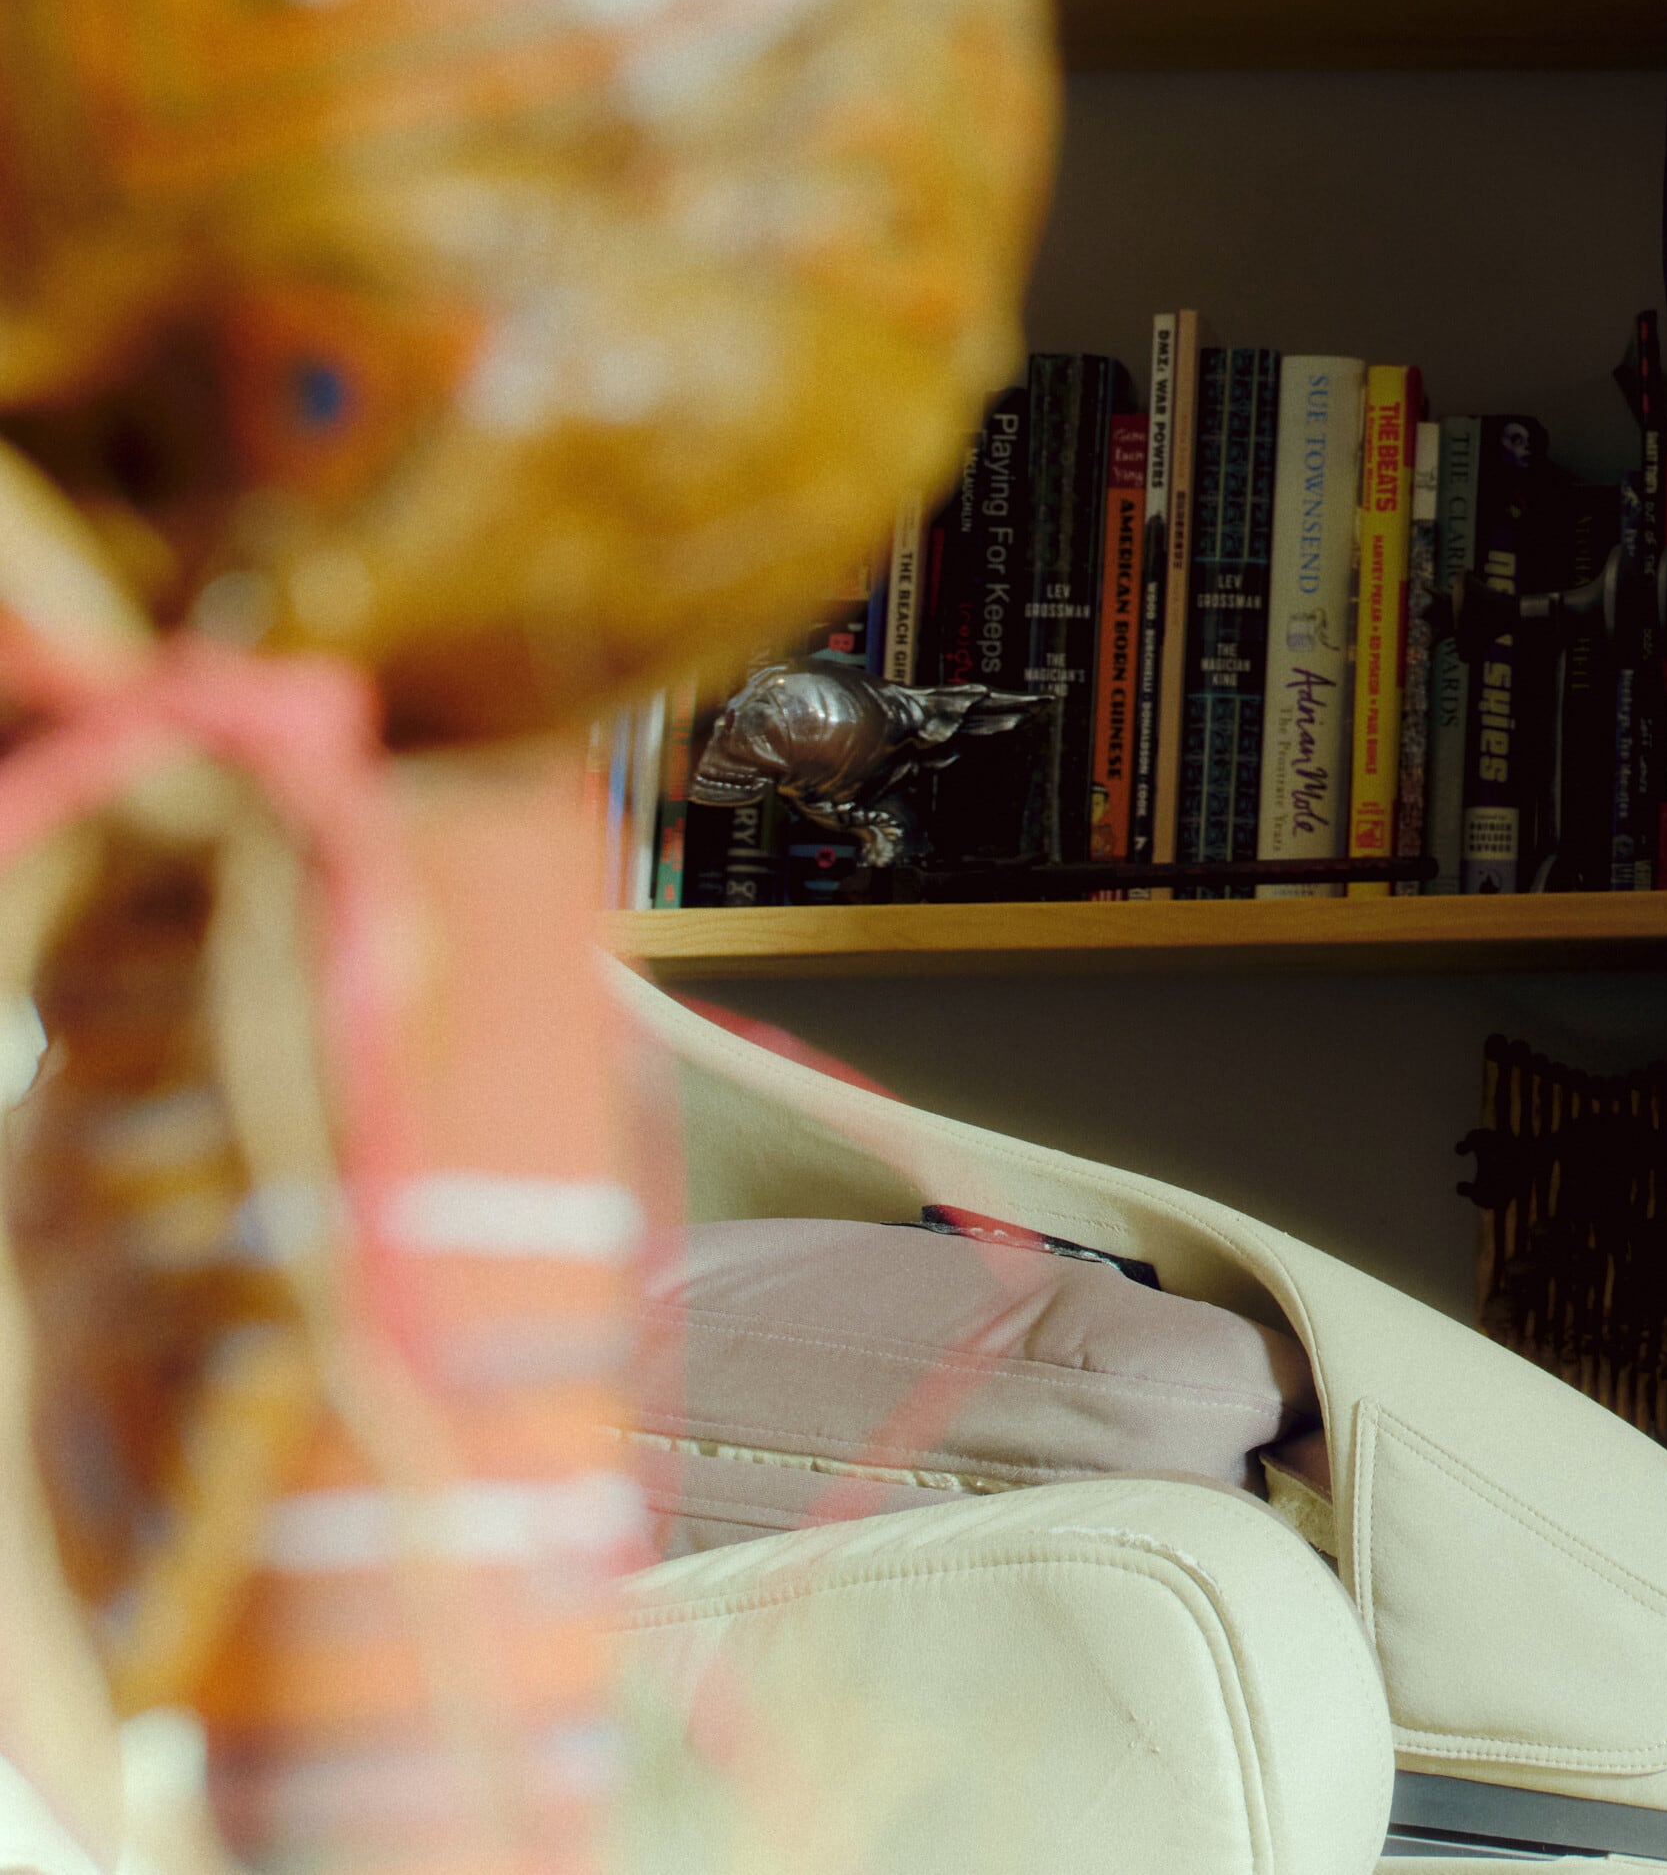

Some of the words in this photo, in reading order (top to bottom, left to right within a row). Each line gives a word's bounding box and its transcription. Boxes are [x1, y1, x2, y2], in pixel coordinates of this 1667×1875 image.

[1156, 329, 1170, 373] DMZ:
[1154, 378, 1169, 415] WAR
[1305, 374, 1331, 424] SUE
[1377, 403, 1400, 443] THE
[982, 413, 1020, 517] Playing
[1151, 421, 1167, 489] POWERS
[1375, 444, 1400, 512] BEATS
[1449, 432, 1471, 486] THE
[1296, 435, 1328, 595] TOWNSEND
[901, 552, 914, 584] THE
[986, 525, 1014, 575] For
[1114, 497, 1137, 613] AMERICAN
[1047, 584, 1071, 599] LEV
[1197, 593, 1262, 610] GROSSMAN
[1218, 574, 1243, 589] LEV
[895, 590, 912, 645] BEACH
[976, 582, 1013, 674] Keeps
[1024, 603, 1091, 619] GROSSMAN
[1046, 653, 1066, 666] THE
[1110, 619, 1132, 682] BORN
[1200, 658, 1251, 672] MAGICIAN
[1216, 643, 1238, 657] THE
[1211, 673, 1238, 686] KING
[1106, 686, 1129, 782] CHINESE
[1277, 706, 1293, 734] The
[1284, 666, 1339, 767] Adrian
[1476, 660, 1516, 783] skies
[1274, 739, 1292, 808] Prostrate
[1290, 767, 1332, 838] Mole
[1271, 812, 1290, 852] Years
